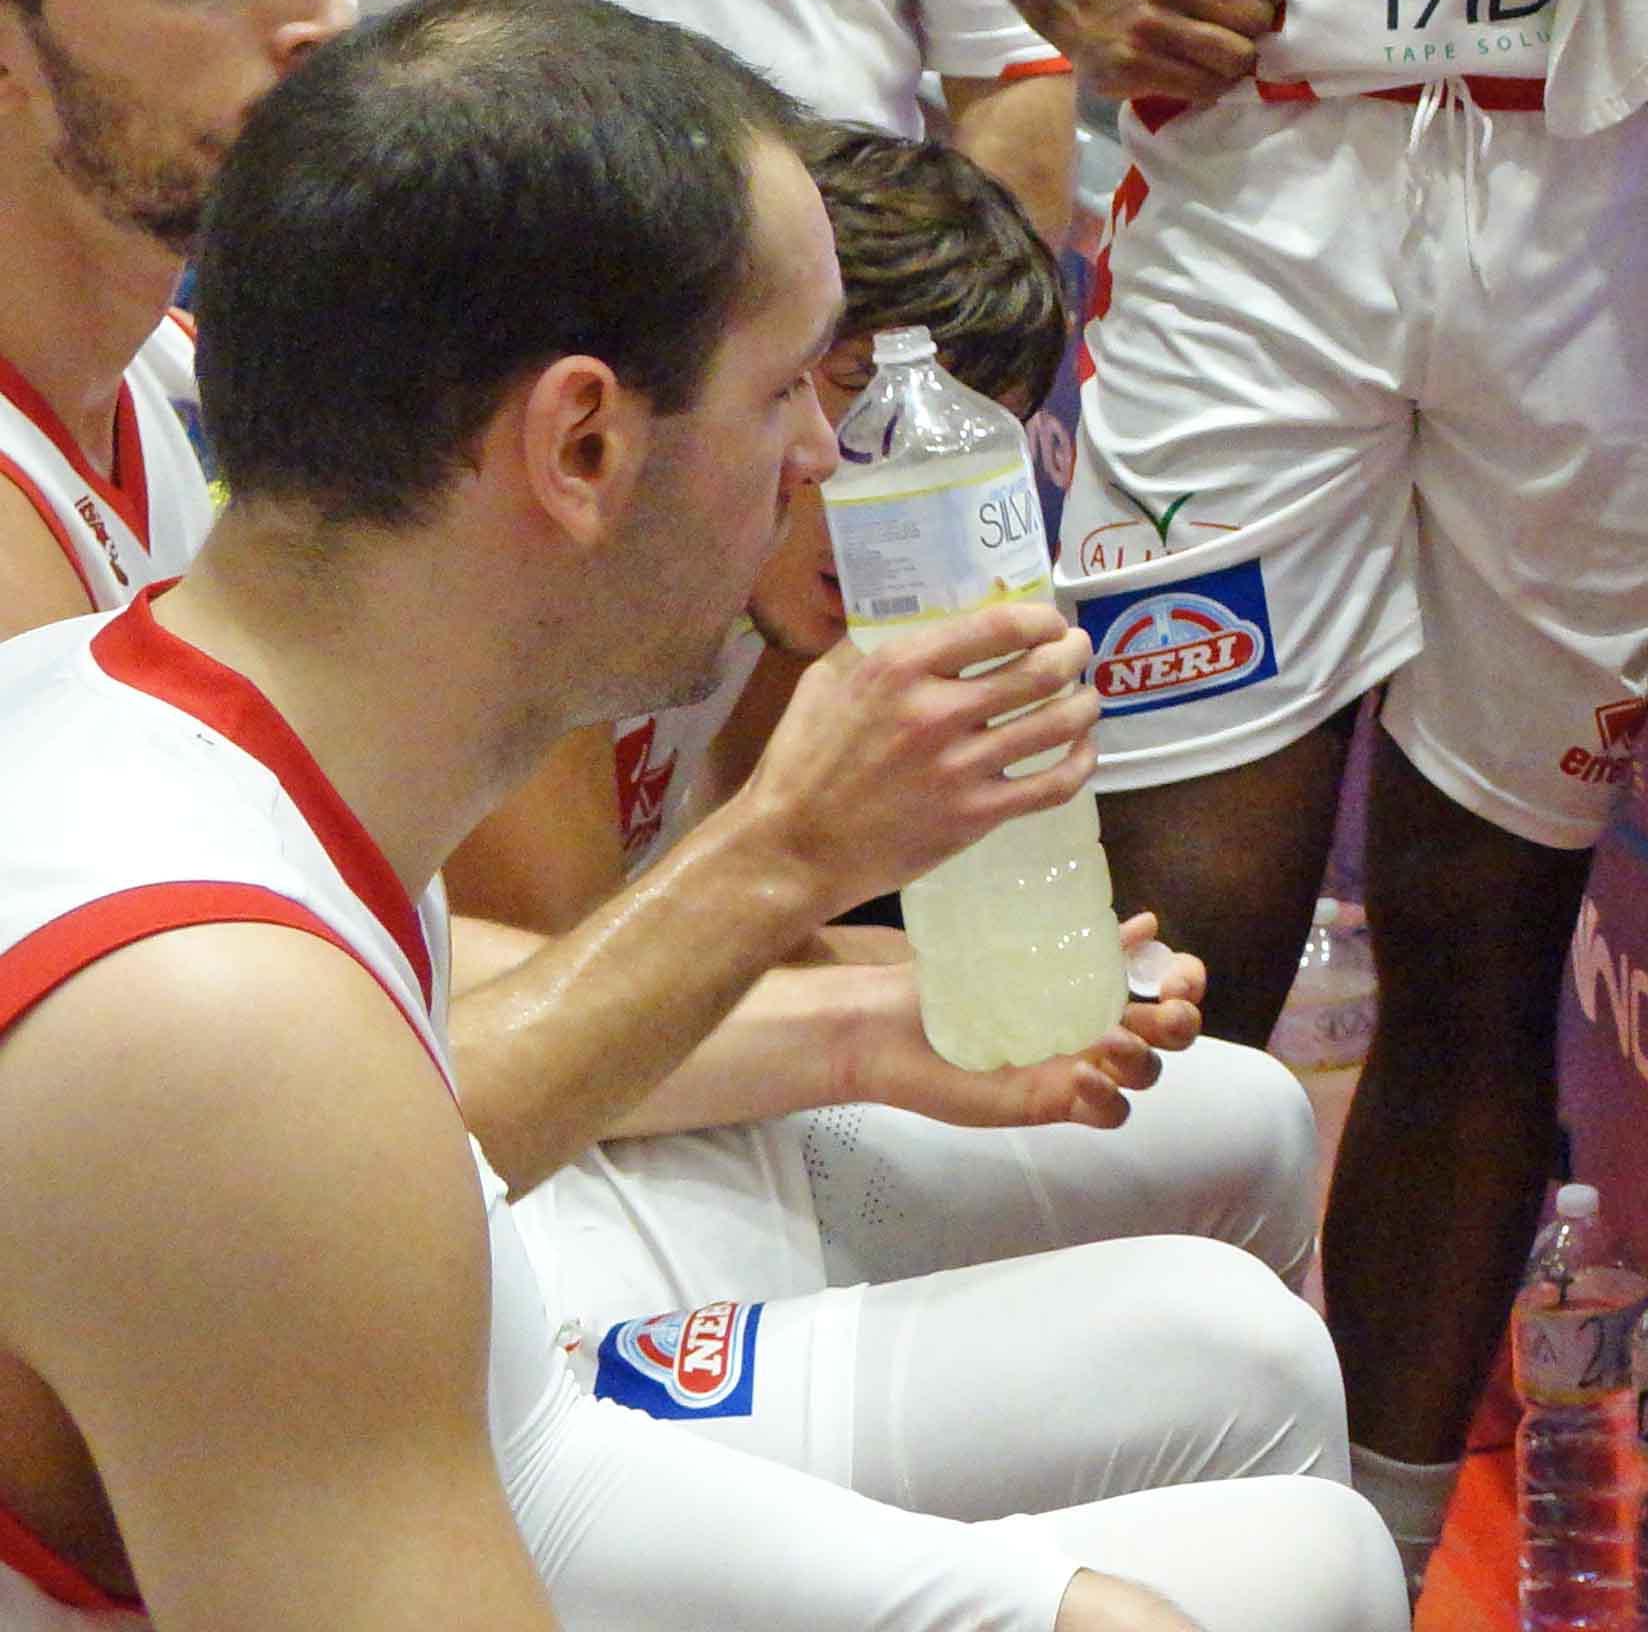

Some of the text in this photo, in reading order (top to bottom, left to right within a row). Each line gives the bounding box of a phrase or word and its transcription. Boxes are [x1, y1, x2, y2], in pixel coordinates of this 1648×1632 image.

[1383, 30, 1553, 66] TAPE SOLU
[1107, 634, 1237, 695] NERI
